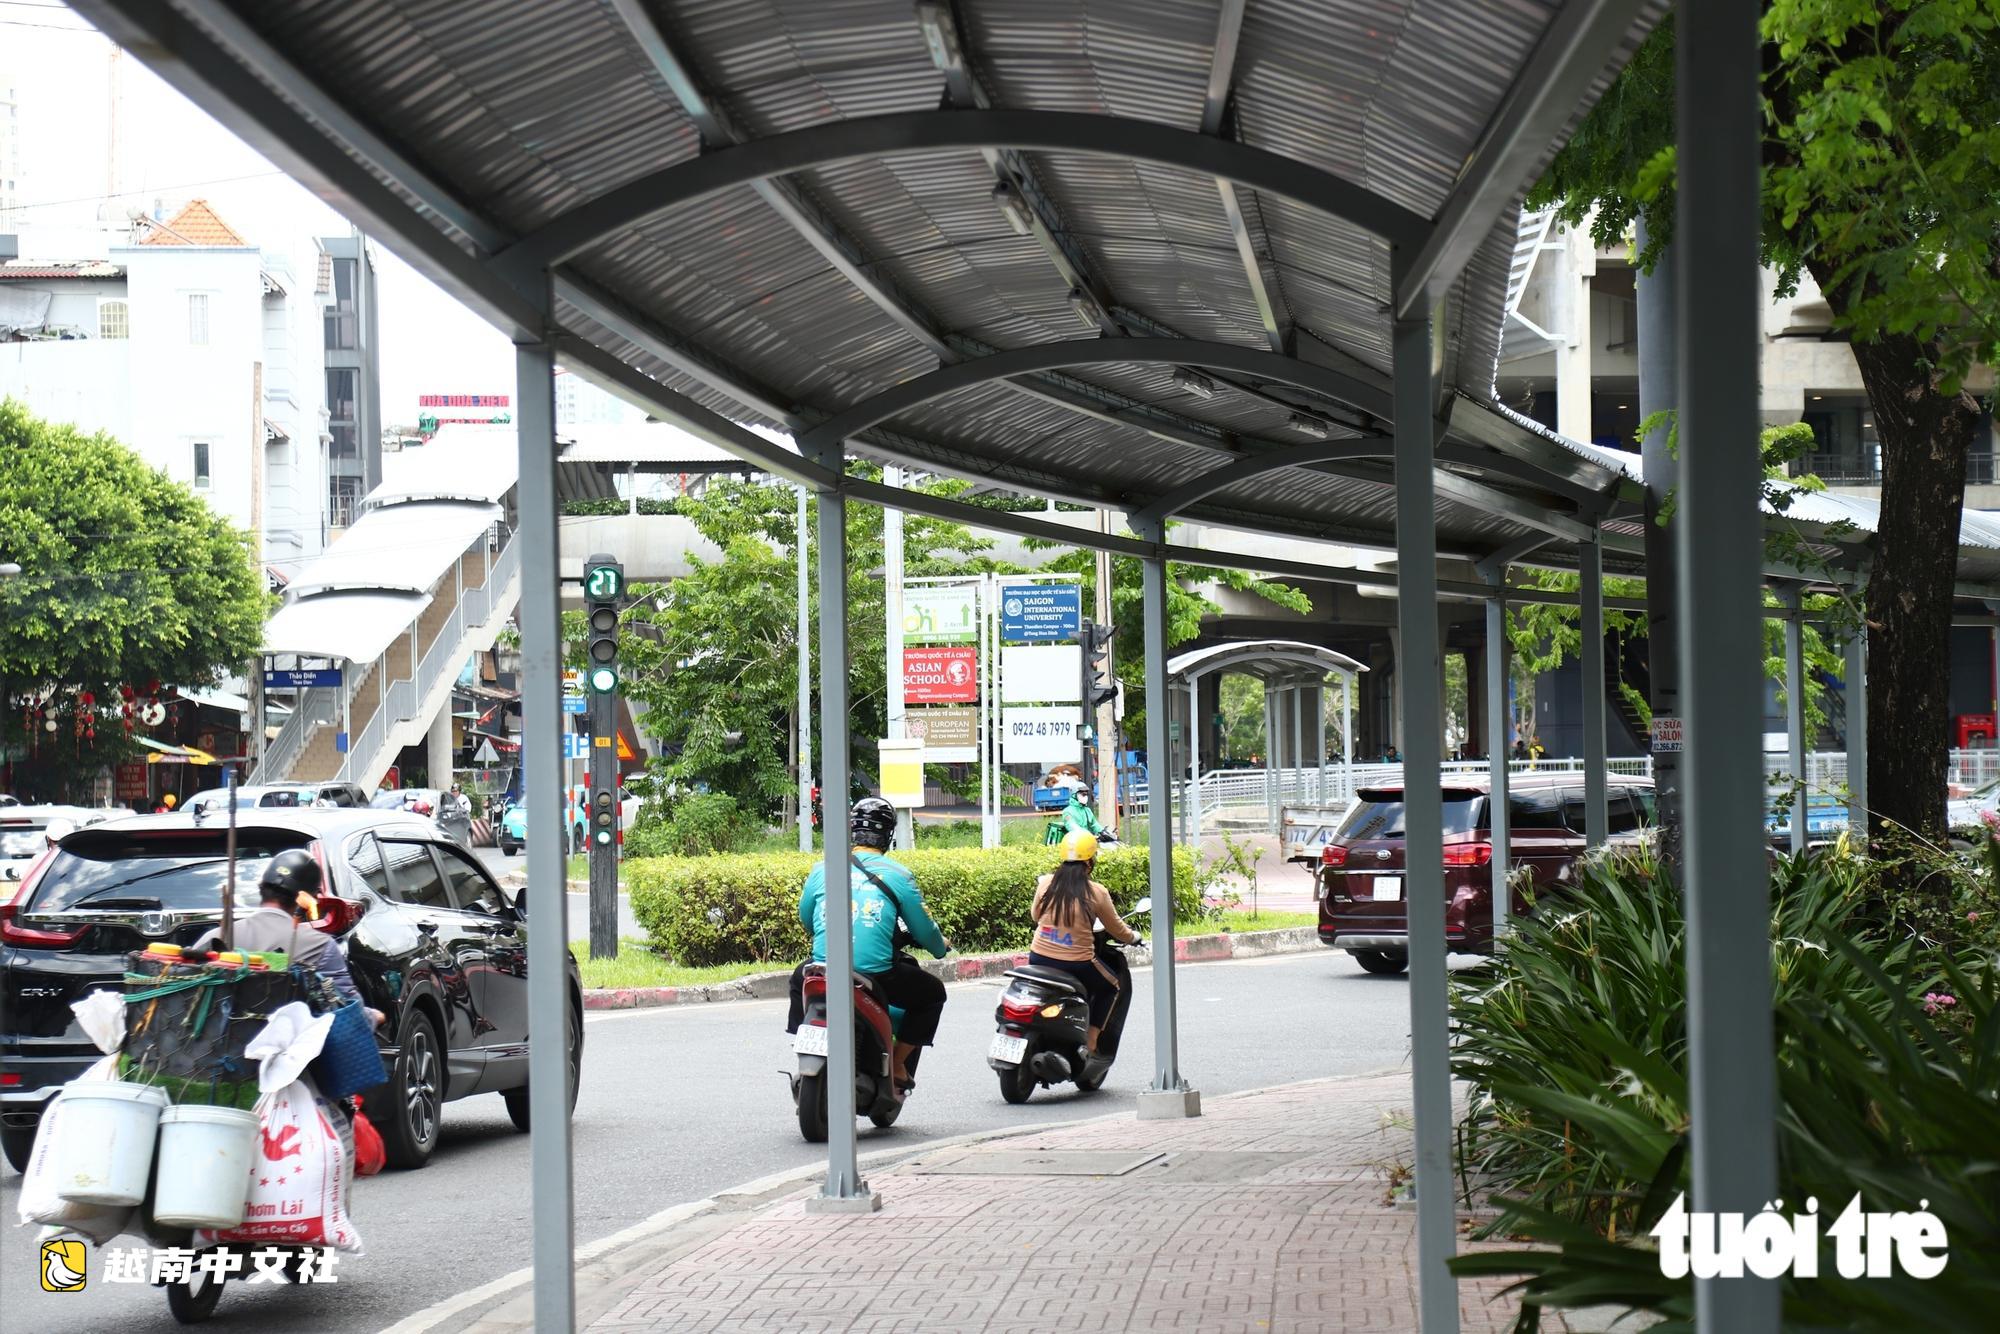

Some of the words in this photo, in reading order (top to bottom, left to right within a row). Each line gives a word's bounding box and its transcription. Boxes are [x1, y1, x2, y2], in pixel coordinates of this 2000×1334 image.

[1023, 597, 1054, 605] SAIGON
[908, 662, 942, 672] ASIAN
[903, 674, 947, 685] SCHOOL
[930, 720, 970, 728] EUROPEAN
[1012, 722, 1034, 736] 0922
[1036, 722, 1047, 736] 48
[1049, 722, 1071, 736] 7979
[1040, 926, 1073, 948] FILA
[20, 988, 64, 997] CR-V
[244, 1202, 276, 1217] hơm
[269, 1221, 287, 1234] Cao
